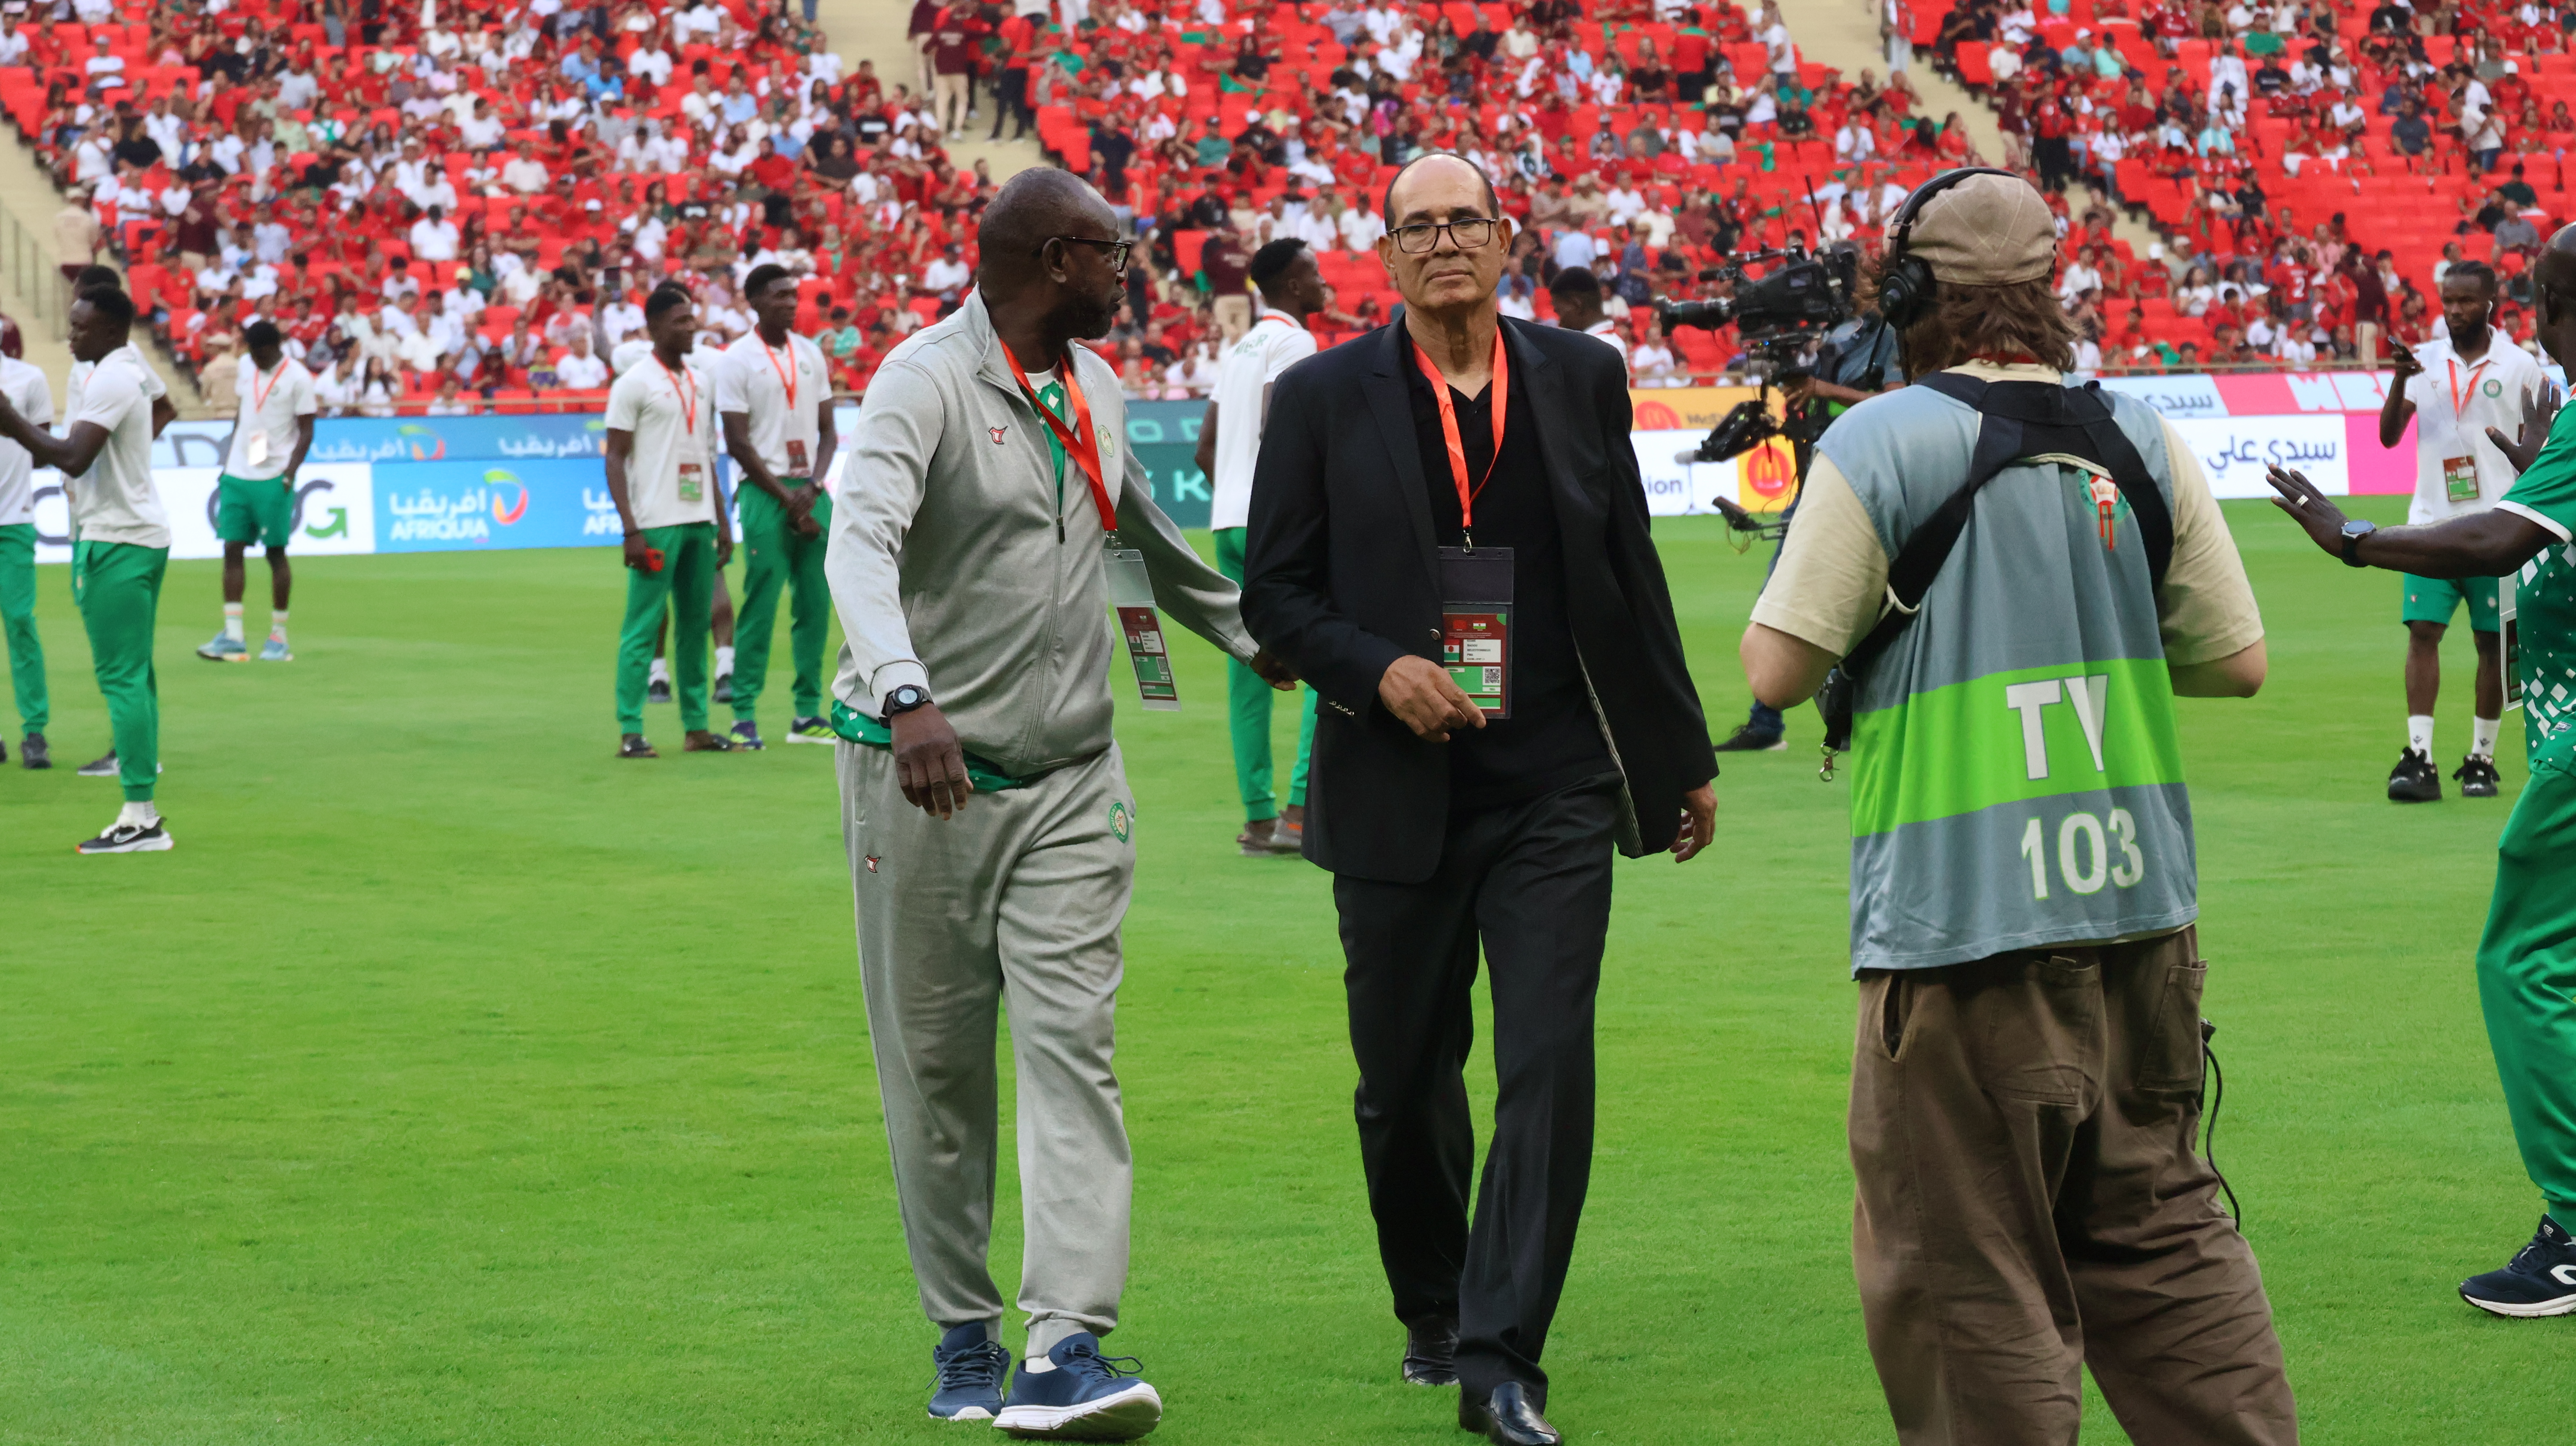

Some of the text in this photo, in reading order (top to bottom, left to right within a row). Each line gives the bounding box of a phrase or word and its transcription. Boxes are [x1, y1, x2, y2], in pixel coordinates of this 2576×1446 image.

[2293, 277, 2305, 296] 2
[1641, 476, 1682, 495] ion
[390, 518, 489, 541] AFRIQUIA
[2006, 674, 2108, 780] TV
[2021, 807, 2144, 901] 103
